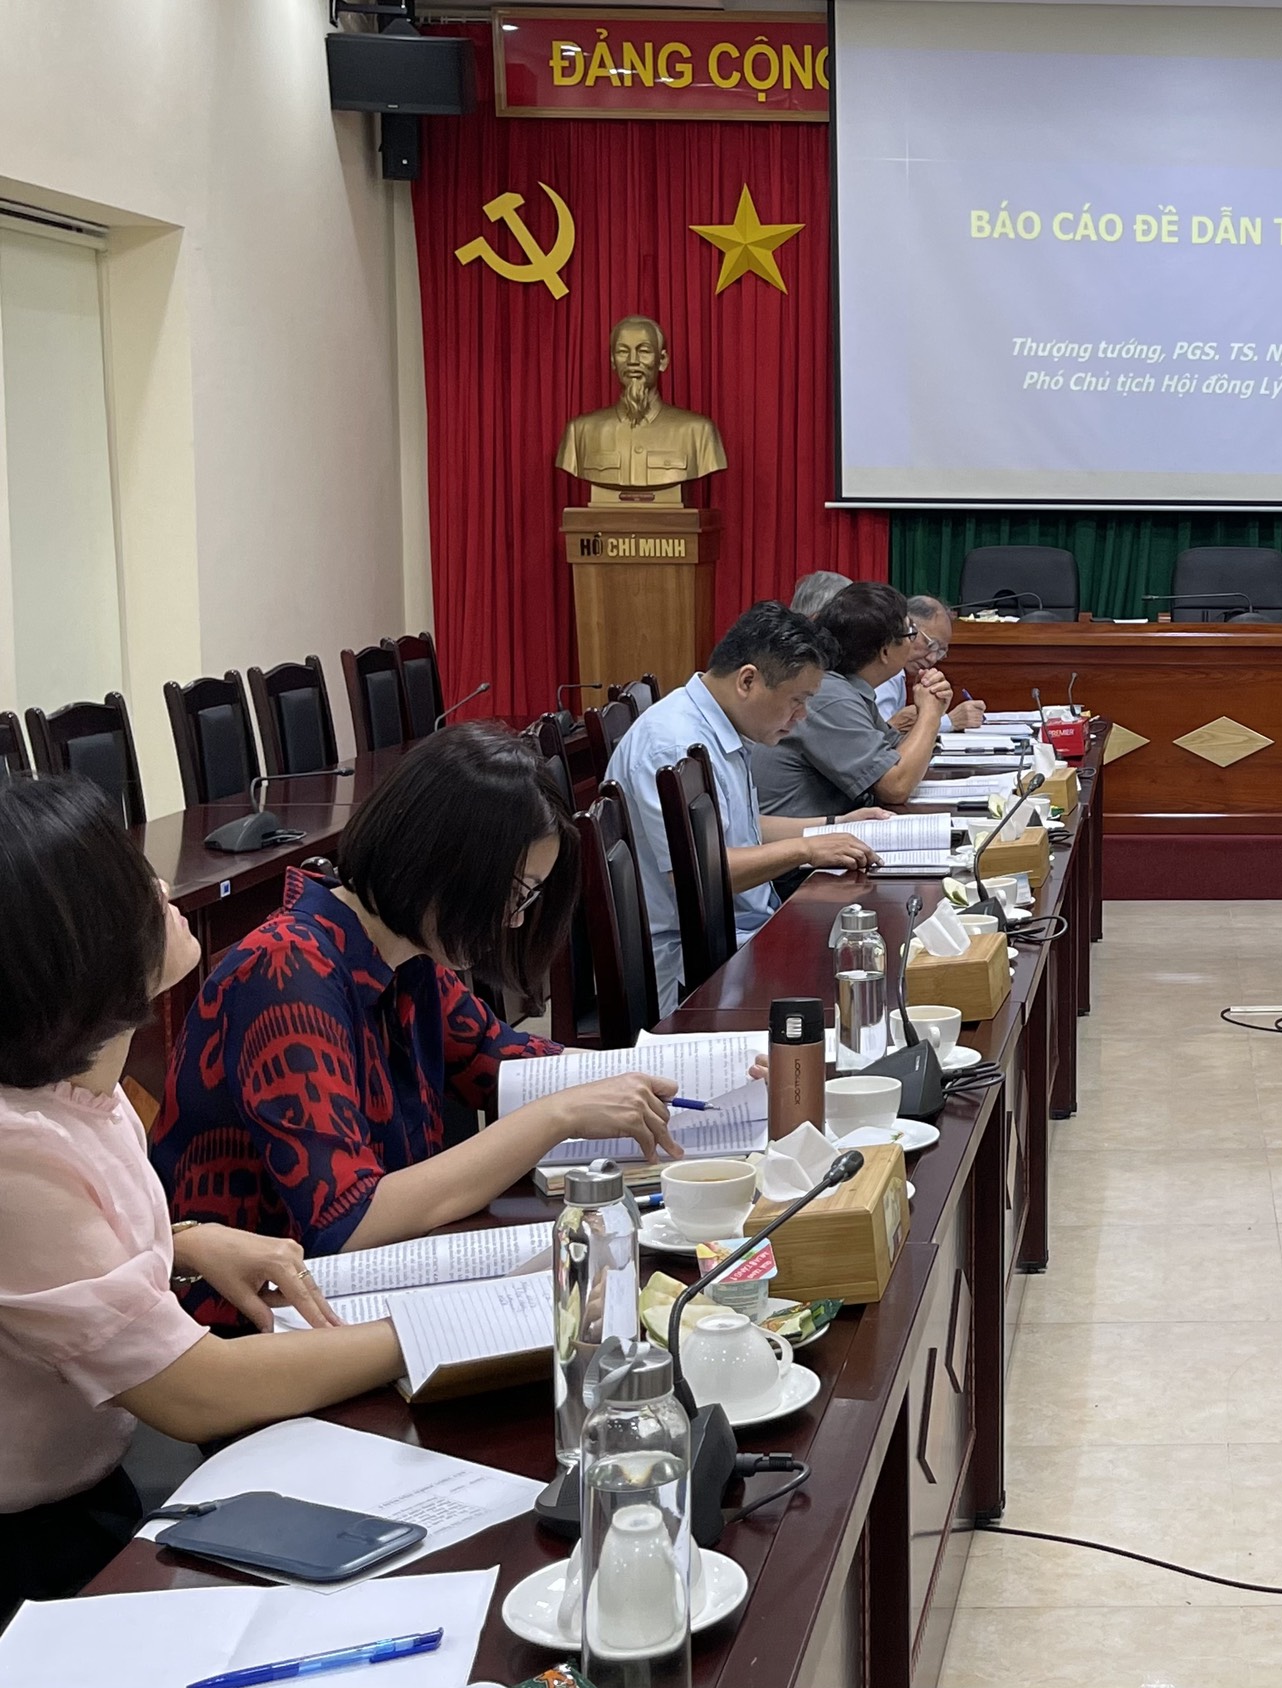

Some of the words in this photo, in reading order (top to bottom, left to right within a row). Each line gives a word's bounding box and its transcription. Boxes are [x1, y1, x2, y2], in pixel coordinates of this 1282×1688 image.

[550, 28, 693, 88] ĐẢNG
[969, 200, 1041, 240] BÁO
[1052, 203, 1123, 242] CÁO
[1133, 205, 1179, 243] ĐỀ
[1191, 207, 1262, 245] DẪN
[1011, 338, 1093, 362] Thượng
[1097, 338, 1166, 363] tướng,
[1172, 342, 1220, 360] PGS.
[1230, 343, 1258, 361] TS.
[1023, 370, 1064, 391] Phó
[1070, 370, 1111, 392] Chủ
[1116, 373, 1156, 397] tịch
[1161, 373, 1198, 398] Hội
[1202, 373, 1255, 399] đồng
[607, 534, 636, 557] CHÍ
[639, 538, 686, 557] MINH
